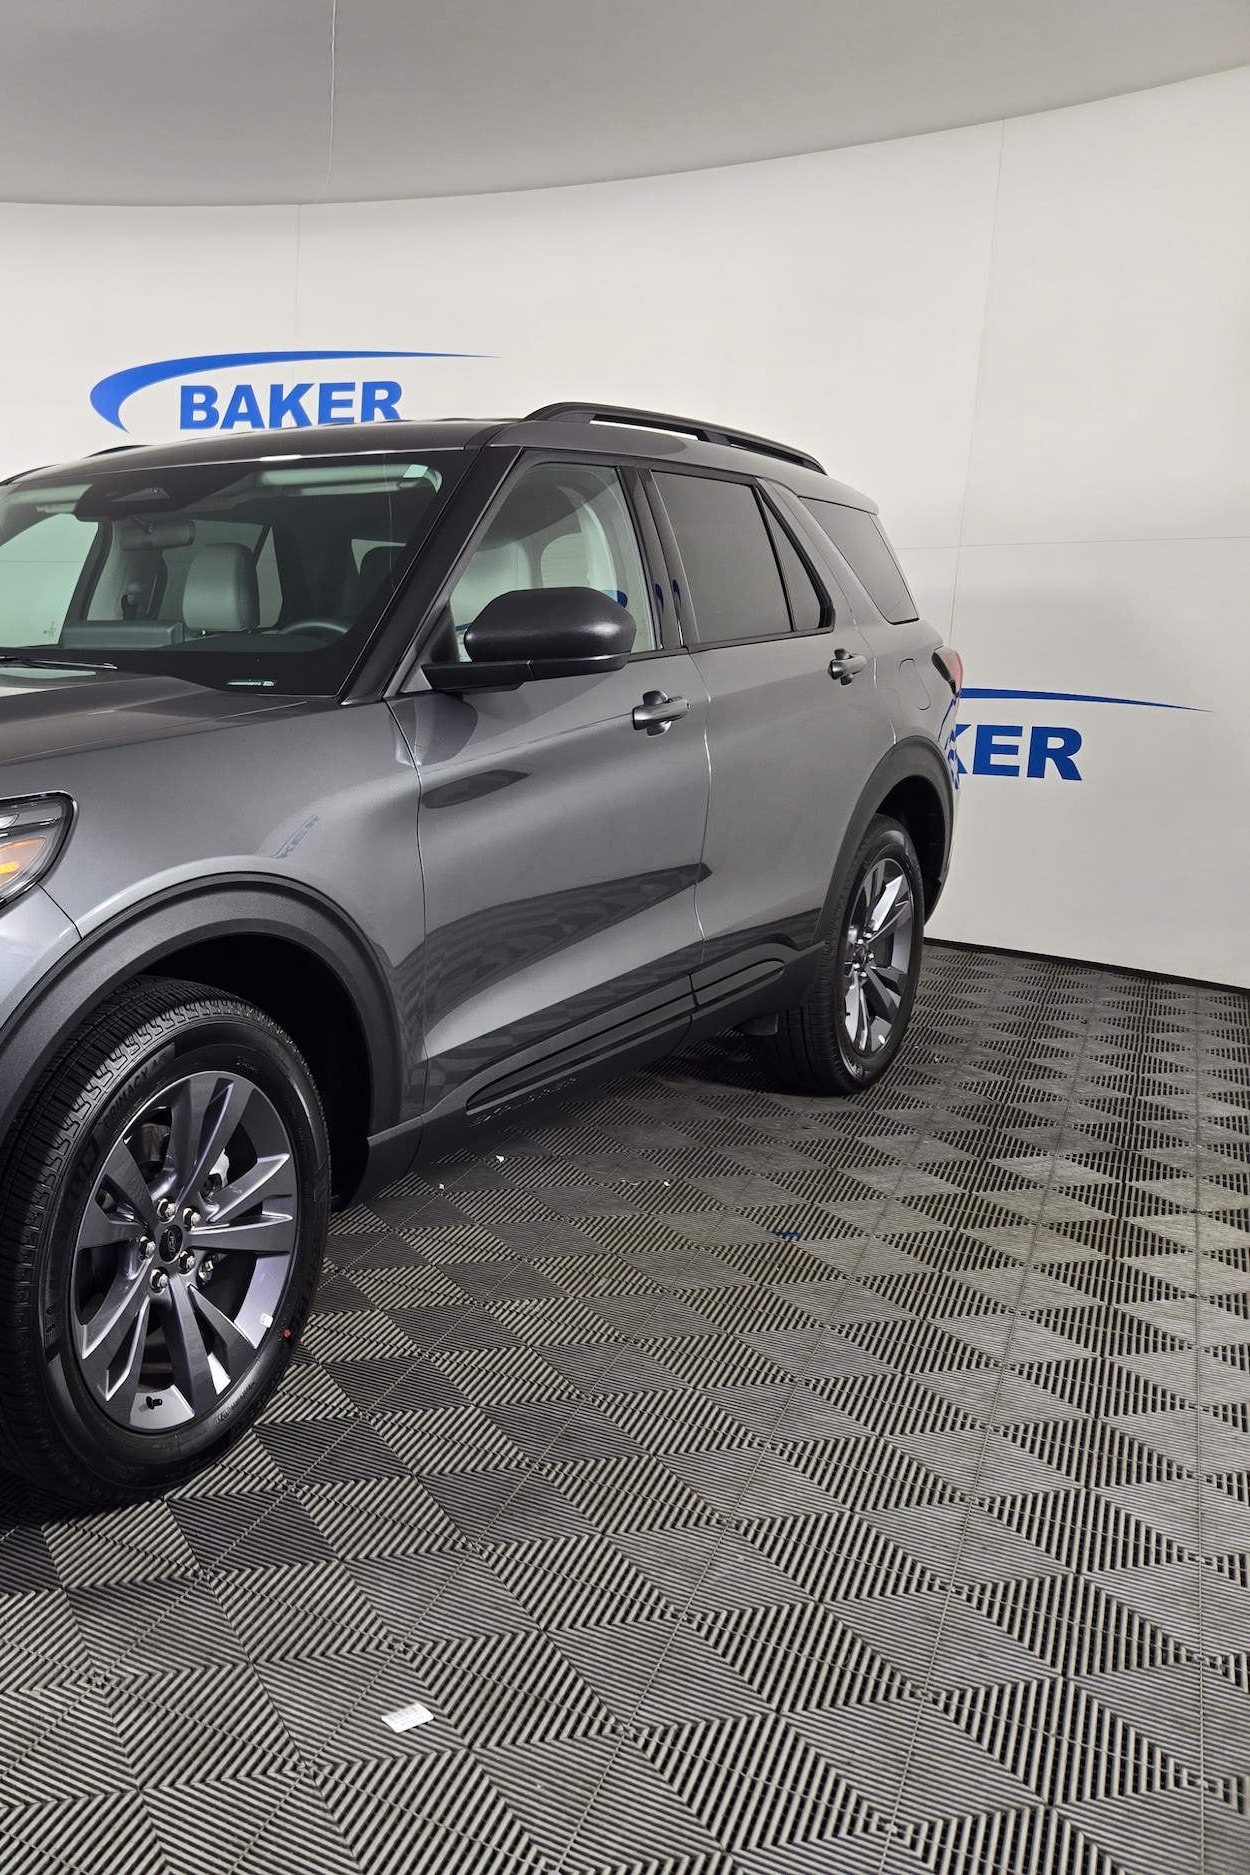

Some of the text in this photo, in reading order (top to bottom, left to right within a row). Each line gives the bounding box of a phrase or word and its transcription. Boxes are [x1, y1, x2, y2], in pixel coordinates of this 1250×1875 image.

[180, 381, 403, 430] BAKER
[956, 723, 1083, 781] ER
[103, 1066, 149, 1129] PRIMACY
